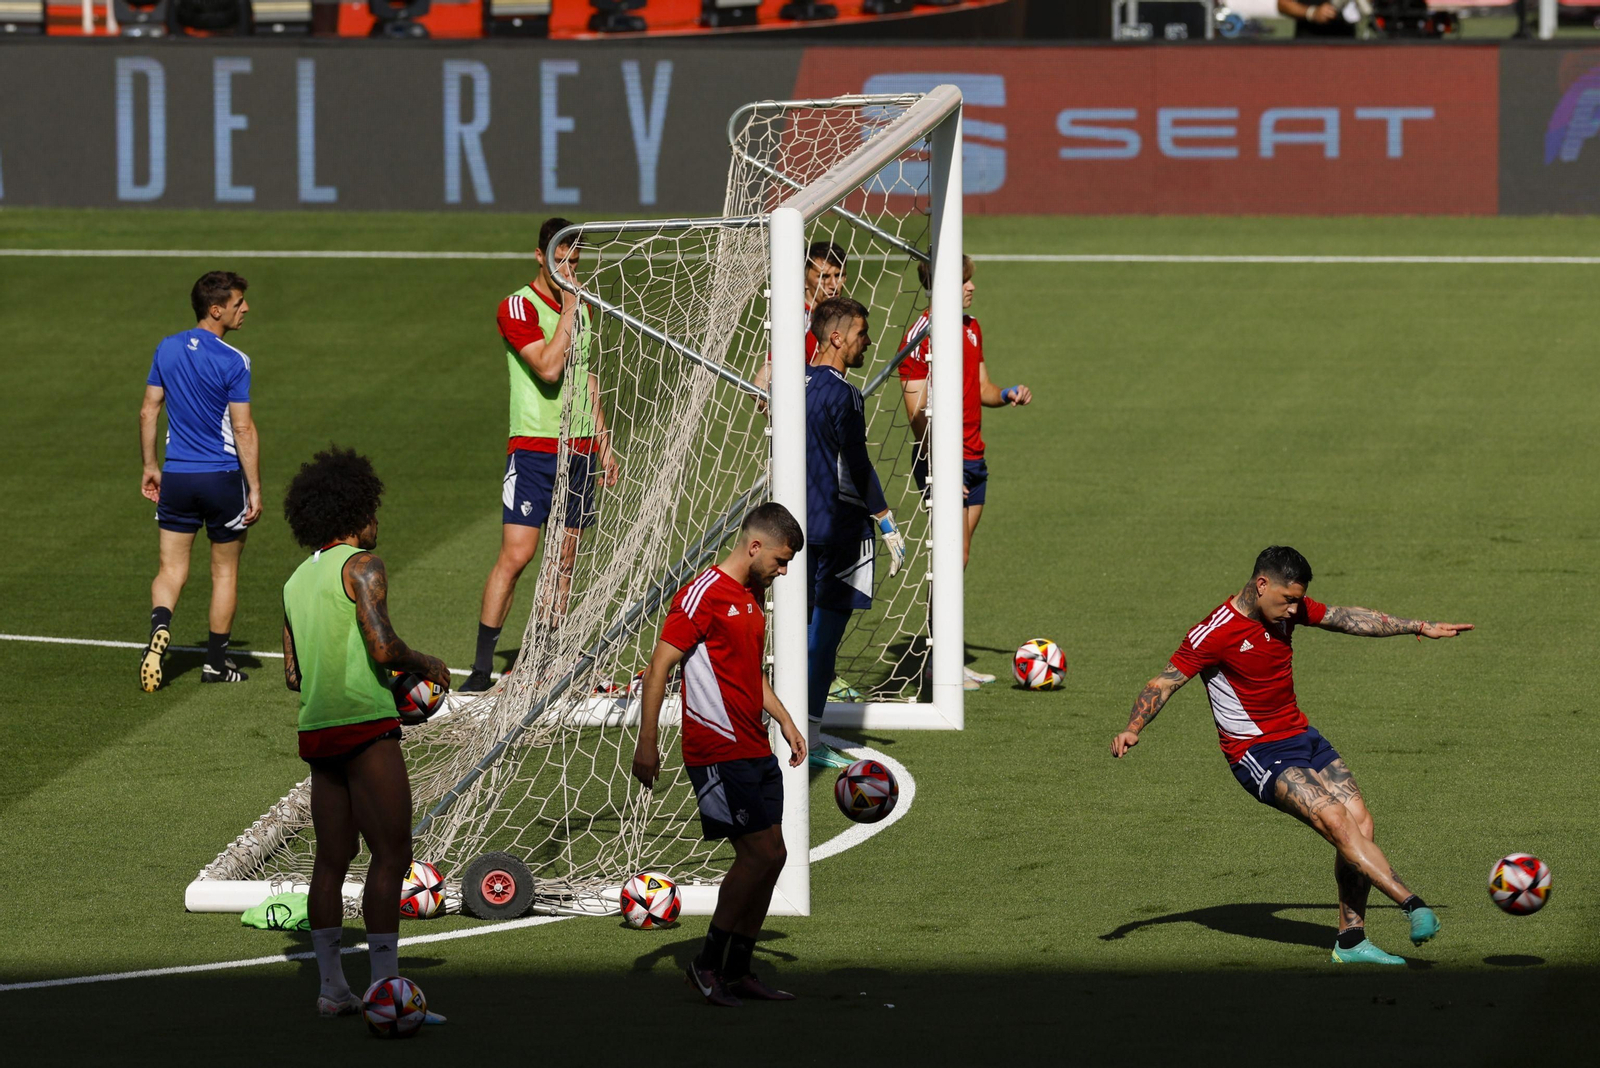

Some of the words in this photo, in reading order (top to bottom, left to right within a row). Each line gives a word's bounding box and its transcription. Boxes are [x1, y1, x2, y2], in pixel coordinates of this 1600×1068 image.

[115, 57, 338, 203] DEL
[442, 59, 673, 206] REY
[1056, 106, 1435, 160] SEAT
